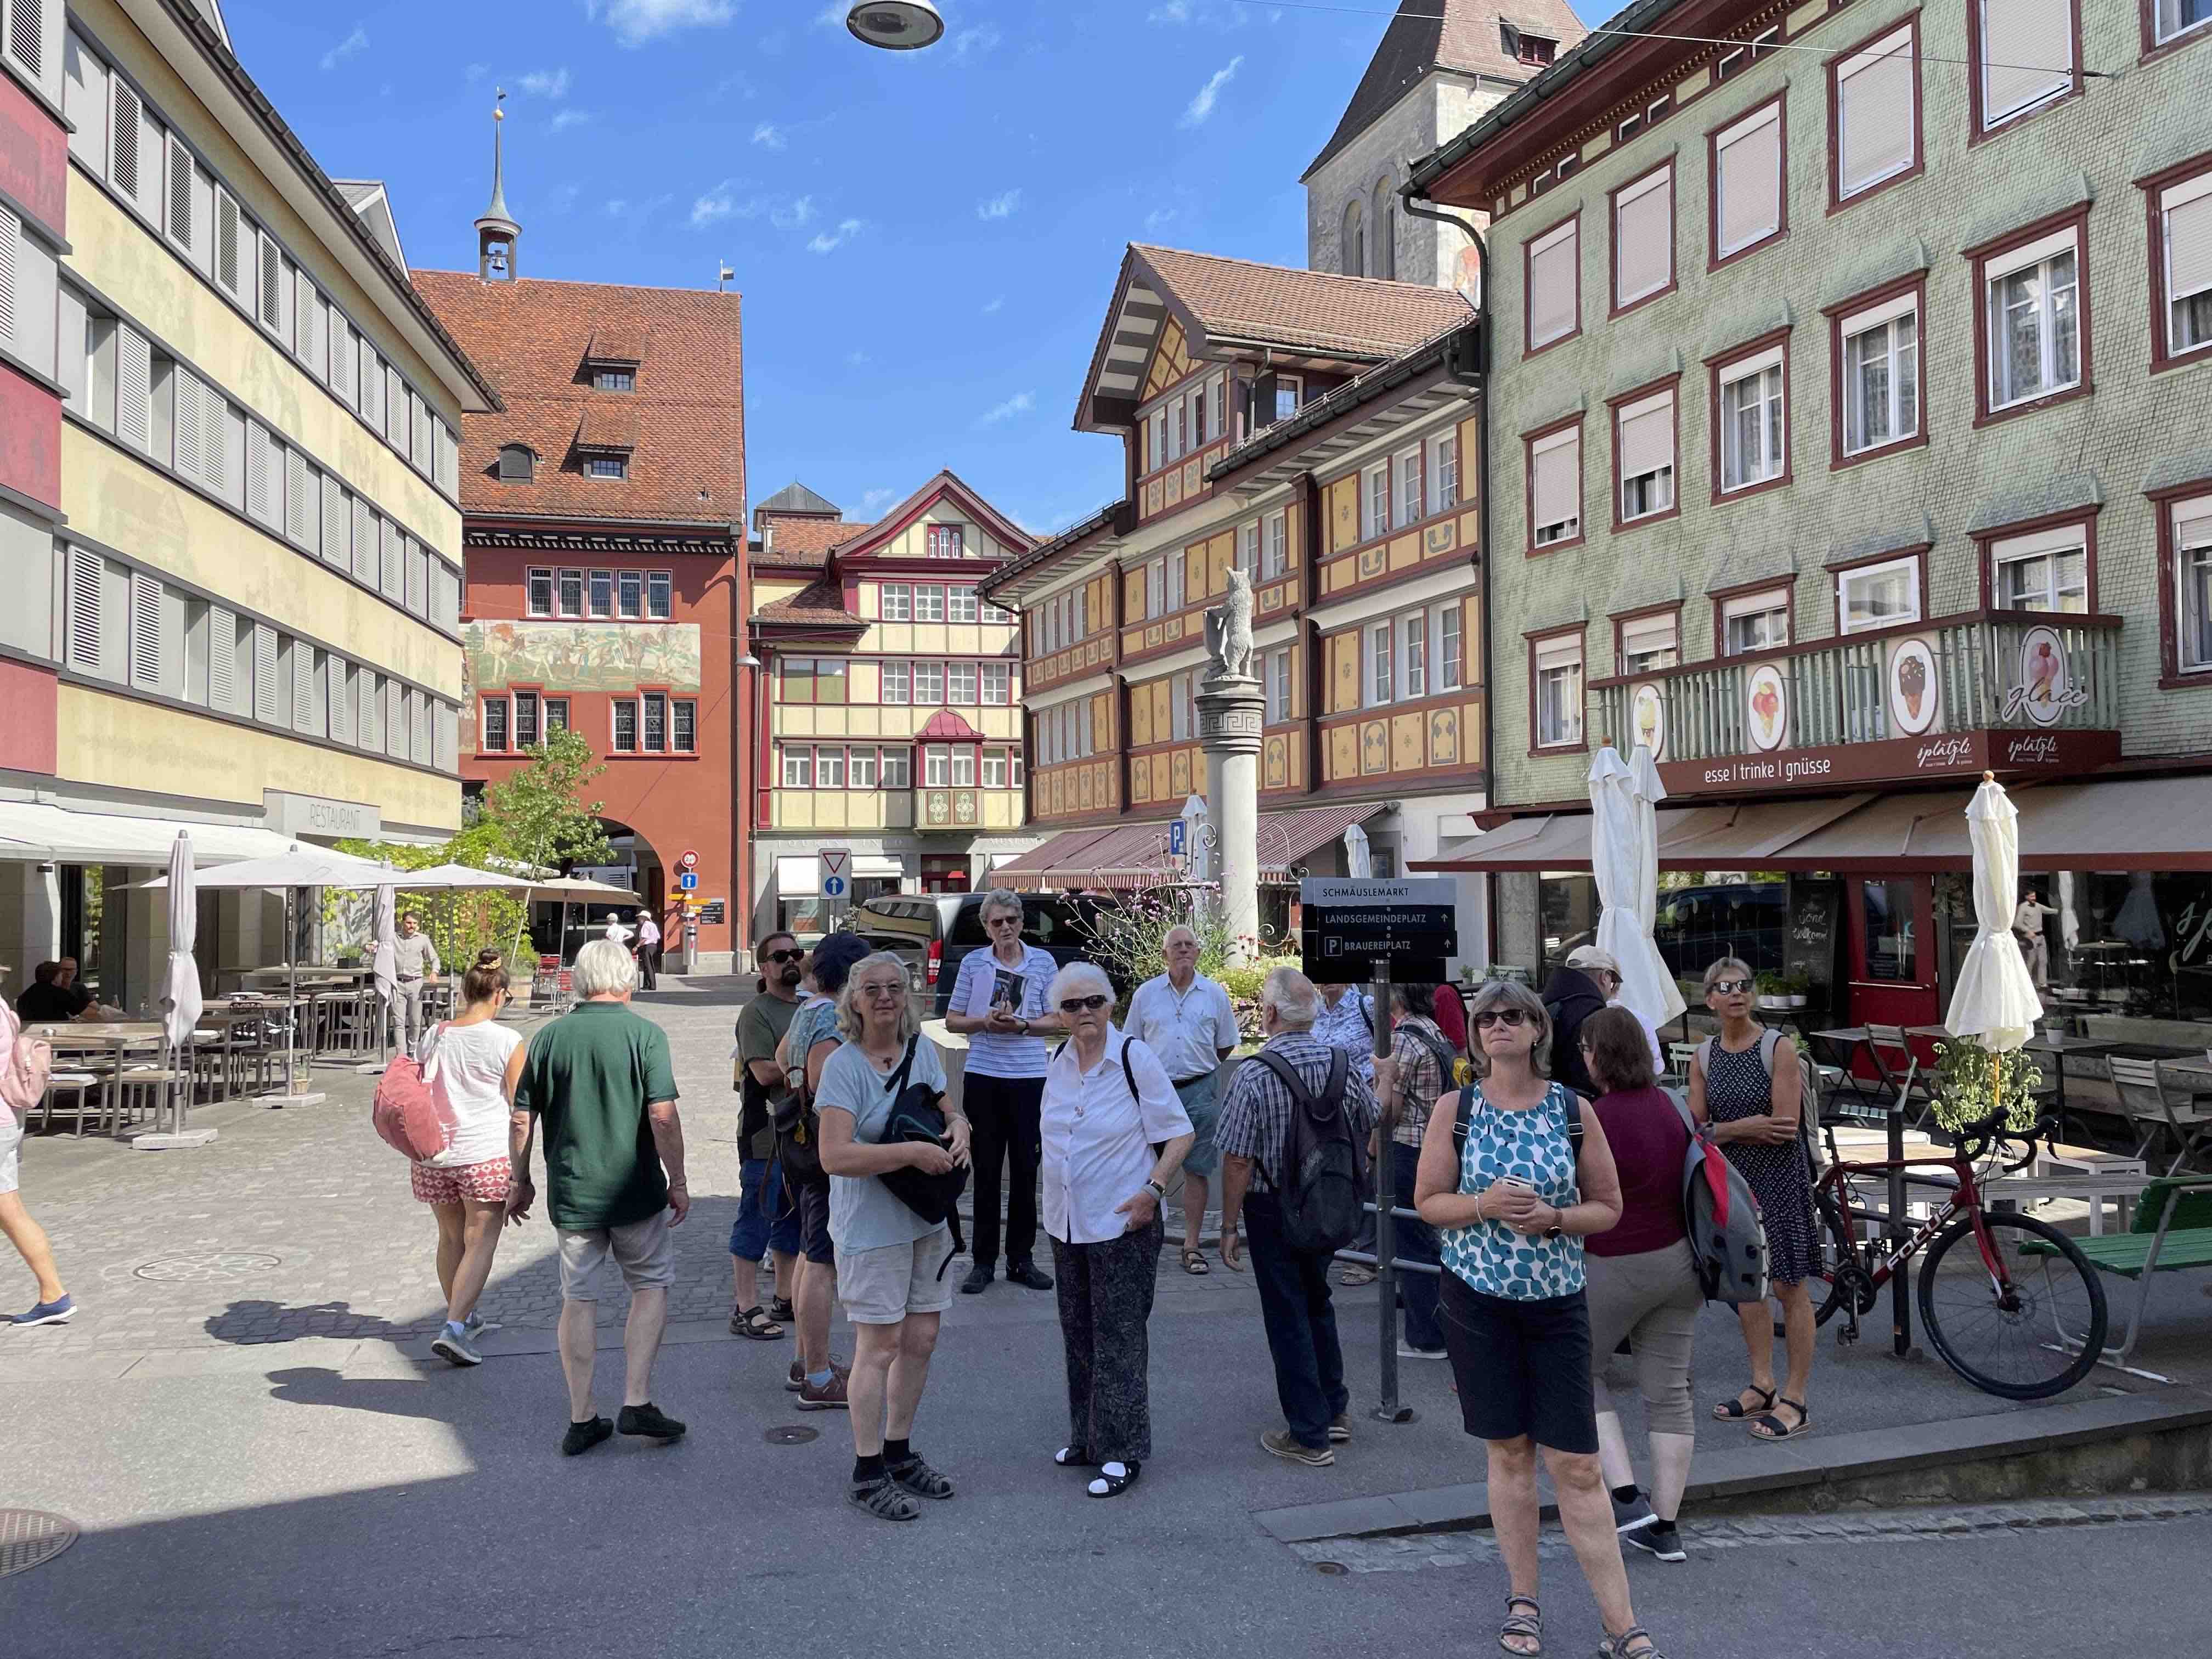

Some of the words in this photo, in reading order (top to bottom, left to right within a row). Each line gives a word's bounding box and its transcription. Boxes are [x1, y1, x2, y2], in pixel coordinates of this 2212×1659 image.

[2004, 676, 2086, 718] glace
[1705, 768, 1730, 783] esse
[1740, 760, 1775, 780] trinke
[1786, 757, 1831, 781] gnüsse
[310, 804, 360, 830] RESTAURANT
[1173, 826, 1180, 848] P
[1323, 885, 1409, 897] SCHMÄUSLEMARKT
[1325, 913, 1426, 924] LANDSGEMEINDEPLATZ
[1329, 939, 1338, 953] P
[1344, 940, 1411, 951] BRAUEREIPLATZ
[1887, 1200, 1956, 1271] FOCUS
